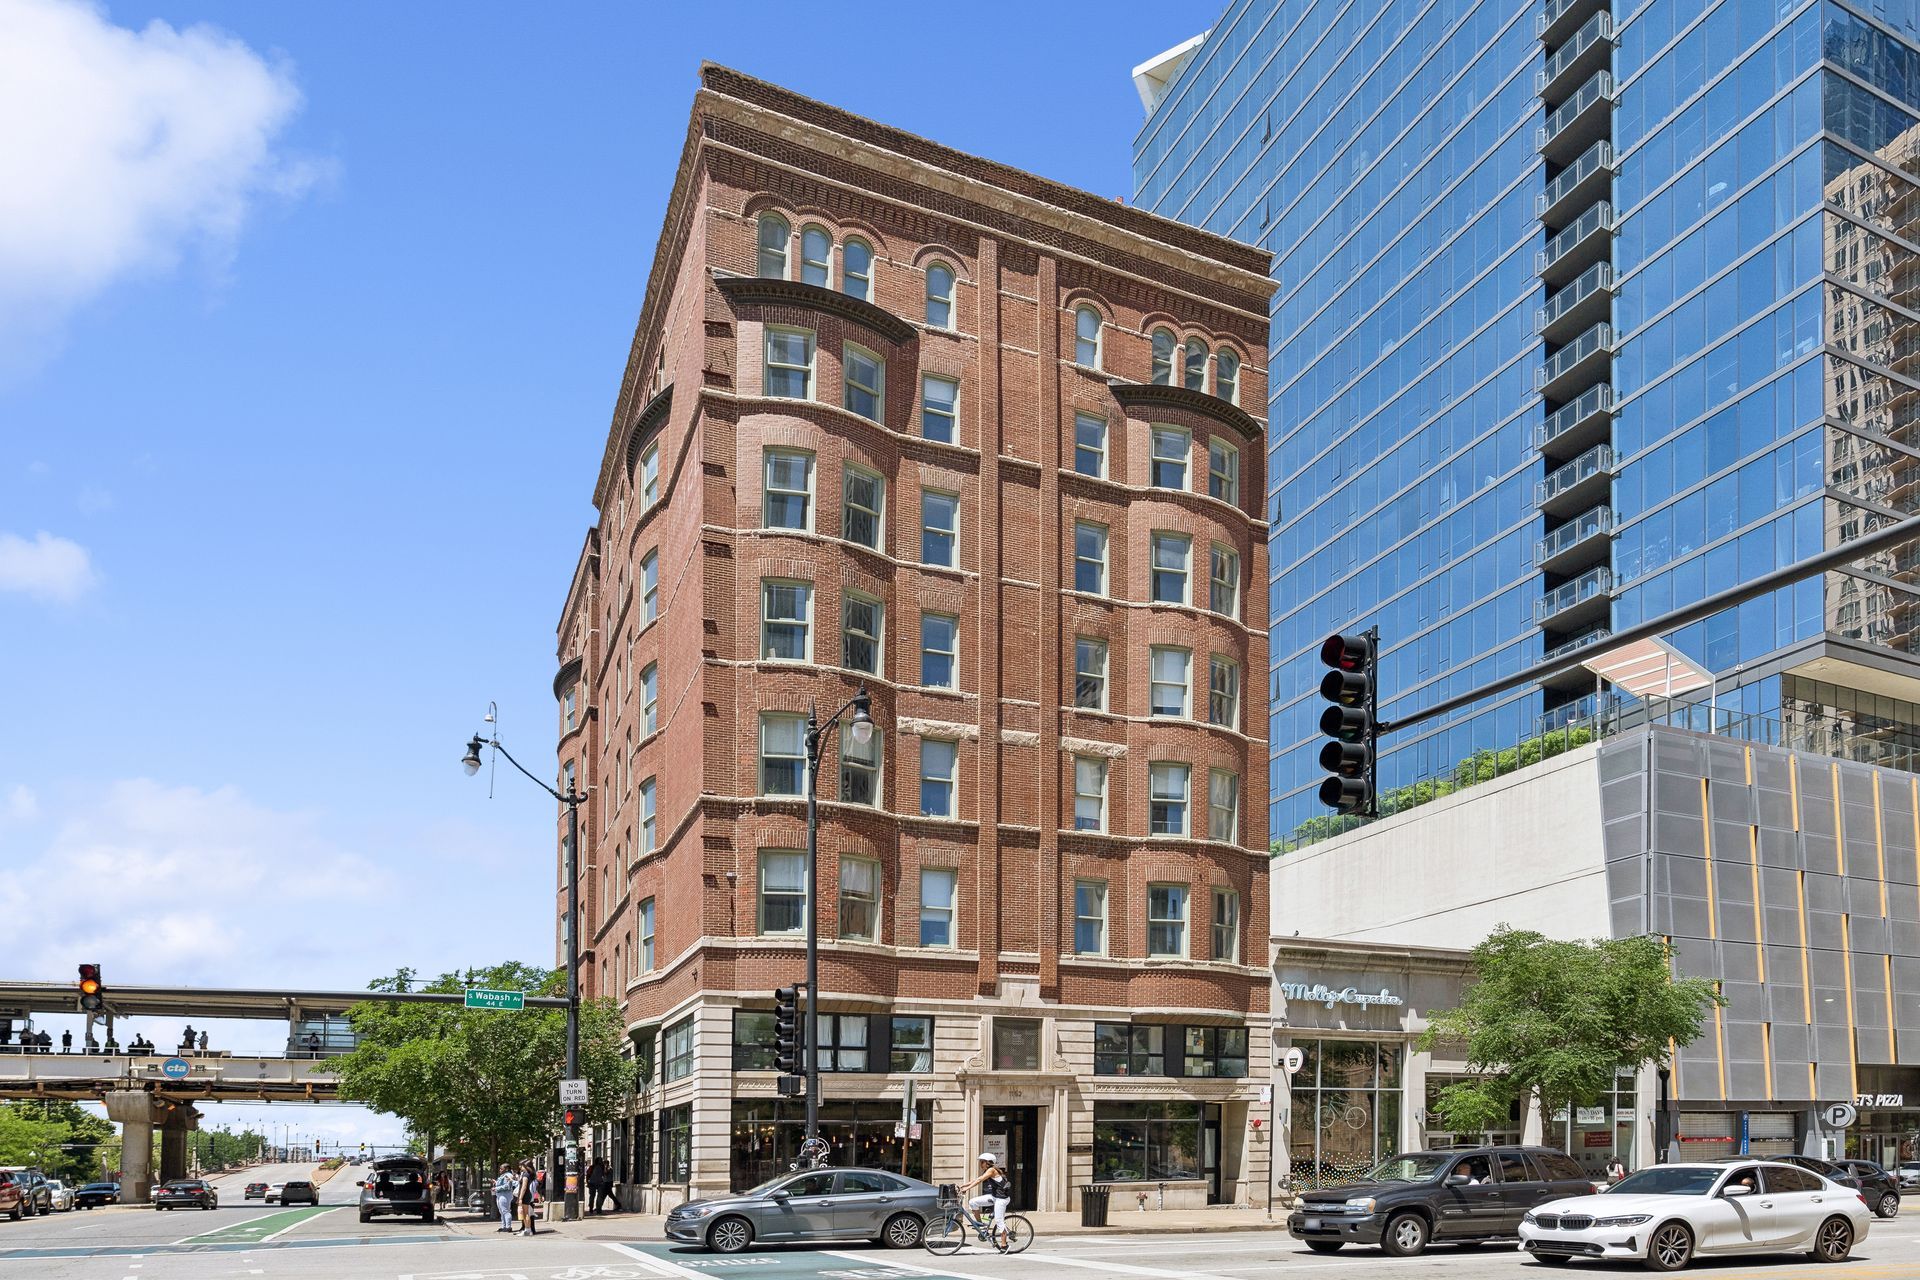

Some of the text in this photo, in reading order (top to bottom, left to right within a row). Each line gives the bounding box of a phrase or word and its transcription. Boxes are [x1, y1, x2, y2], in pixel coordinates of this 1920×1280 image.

[475, 992, 510, 1001] Wabash
[1341, 987, 1403, 1011] Cupcakes
[166, 1064, 186, 1073] cta
[1875, 1094, 1903, 1107] PIZZA
[1832, 1108, 1845, 1124] P
